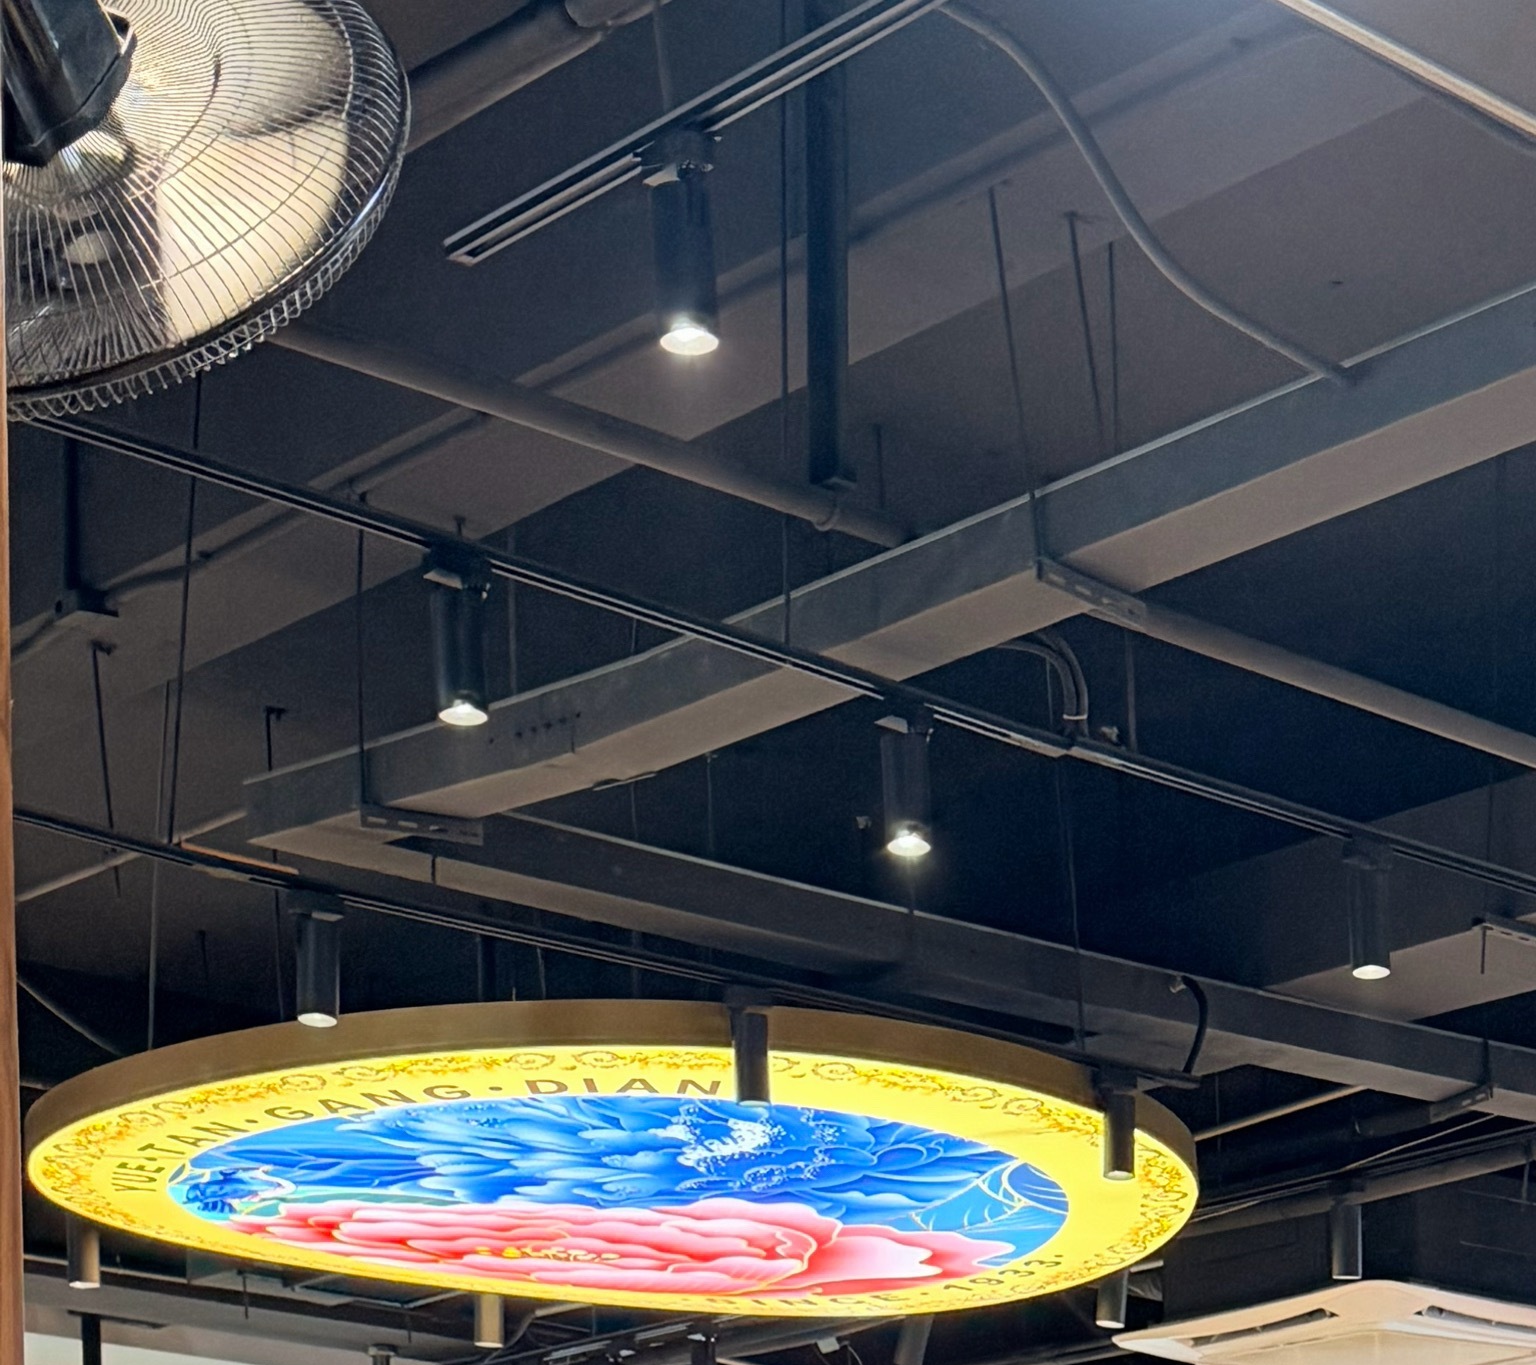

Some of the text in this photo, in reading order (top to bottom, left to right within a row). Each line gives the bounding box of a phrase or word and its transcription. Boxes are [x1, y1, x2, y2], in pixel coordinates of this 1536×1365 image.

[111, 1077, 722, 1192] YUE TAN GANG DIAN
